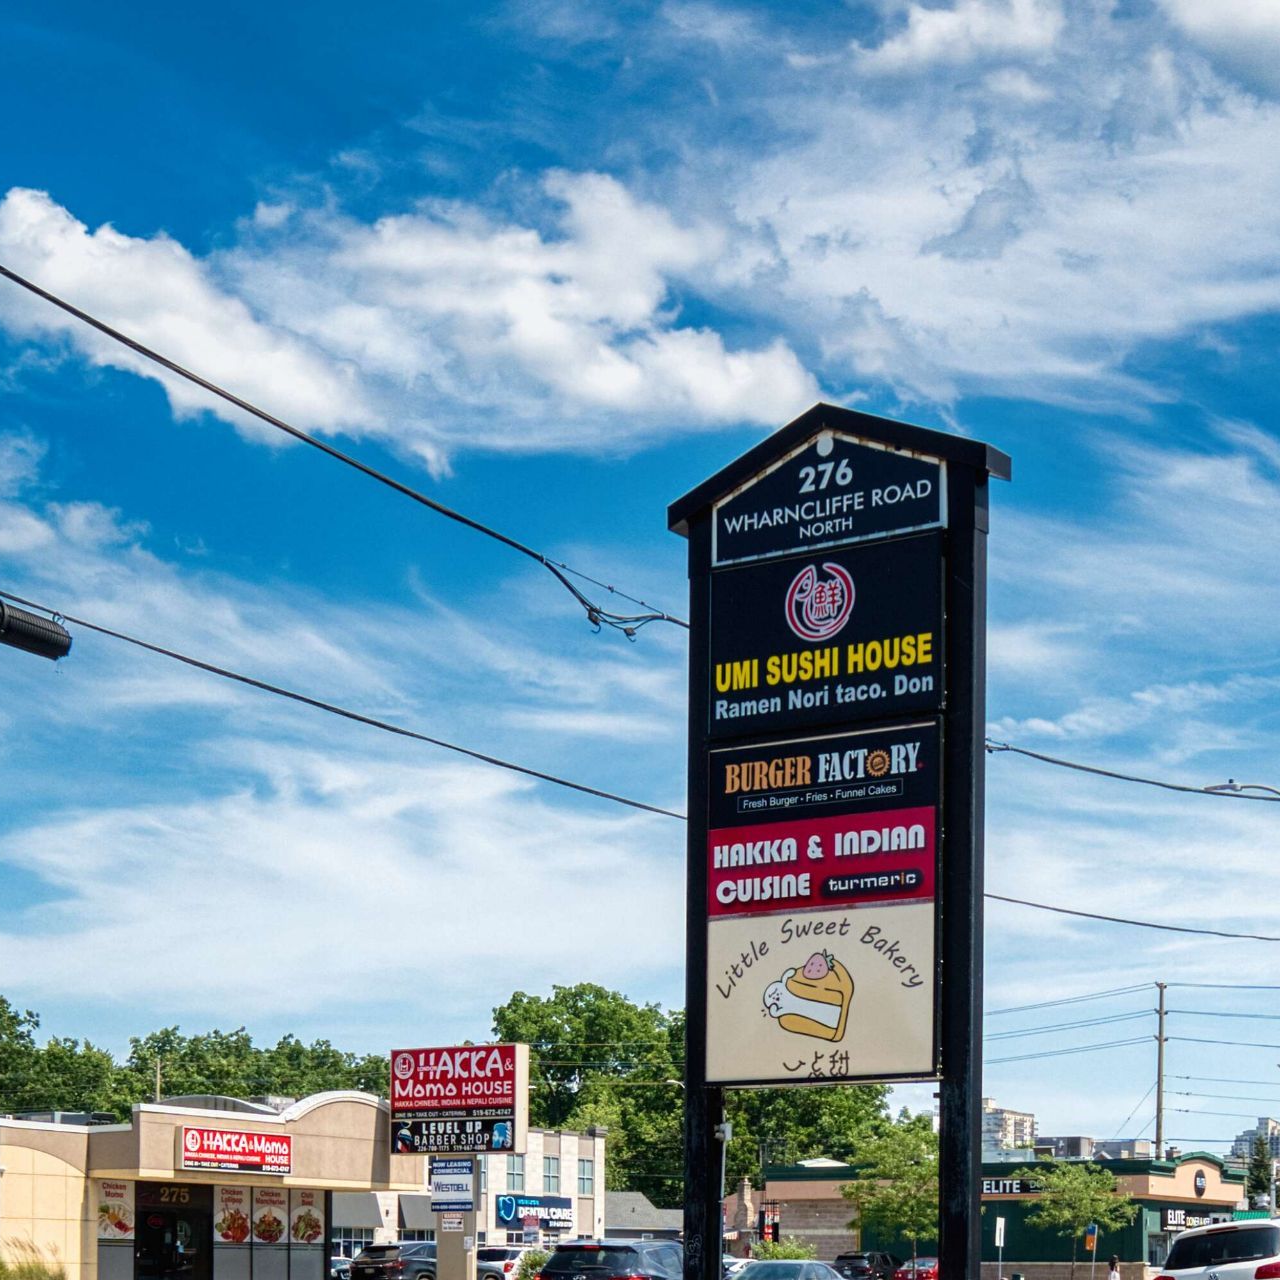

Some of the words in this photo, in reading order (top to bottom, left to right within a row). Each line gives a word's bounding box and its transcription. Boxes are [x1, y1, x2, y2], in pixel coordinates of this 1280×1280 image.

[798, 458, 853, 494] 276
[724, 491, 865, 535] WHARNCLIFFE
[872, 479, 932, 507] ROAD
[799, 516, 853, 539] NORTH
[715, 658, 758, 693] UMI
[766, 646, 839, 686] SUSHI
[847, 632, 933, 674] HOUSE
[715, 693, 781, 720] Ramen
[788, 685, 829, 711] Nori
[894, 674, 934, 696] Don
[725, 755, 811, 795] BURGER
[743, 798, 767, 810] Fresh
[769, 794, 799, 808] Burger
[806, 792, 828, 803] Fries
[835, 787, 866, 800] Funnel
[868, 783, 897, 796] Cakes
[714, 838, 798, 870] HAKKA
[807, 835, 824, 860] &
[834, 824, 925, 857] INDIAN
[716, 872, 811, 904] CUISINE
[828, 872, 916, 891] turmeric
[716, 938, 770, 999] Little
[780, 917, 851, 945] Sweet
[860, 925, 924, 989] Bakery
[419, 1048, 504, 1080] HAKKA
[504, 1058, 514, 1071] &
[394, 1079, 457, 1098] Momo
[462, 1080, 513, 1096] HOUSE
[395, 1100, 413, 1108] HAKKA
[414, 1135, 457, 1146] BARBER
[461, 1133, 490, 1145] SHOP
[422, 1122, 460, 1135] LEVEL
[466, 1121, 482, 1133] UP
[203, 1132, 249, 1153] HAKKA
[253, 1136, 289, 1155] Momo
[265, 1155, 289, 1165] HOUSE
[160, 1187, 189, 1203] 275
[983, 1180, 1020, 1193] ELITE
[1167, 1209, 1185, 1225] ELITE
